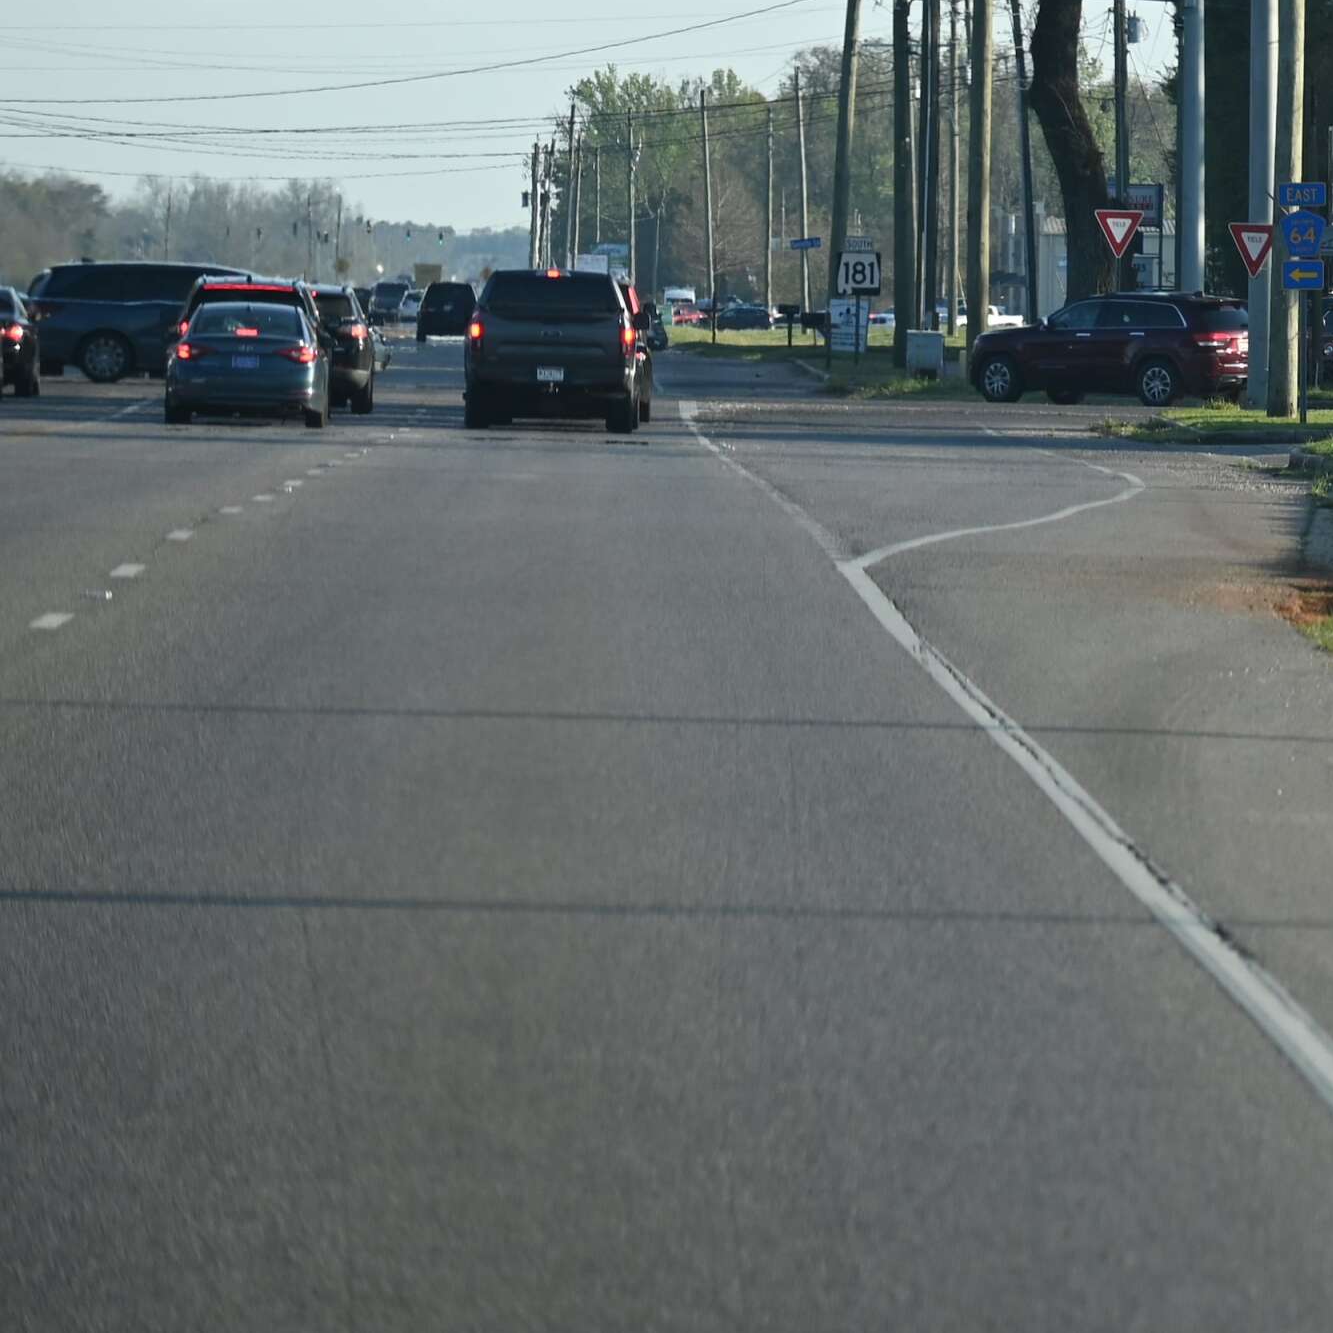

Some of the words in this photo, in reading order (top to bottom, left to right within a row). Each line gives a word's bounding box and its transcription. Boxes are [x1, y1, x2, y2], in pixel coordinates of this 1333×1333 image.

[1286, 187, 1318, 202] EAST
[1290, 227, 1316, 244] 64
[843, 261, 875, 285] 181
